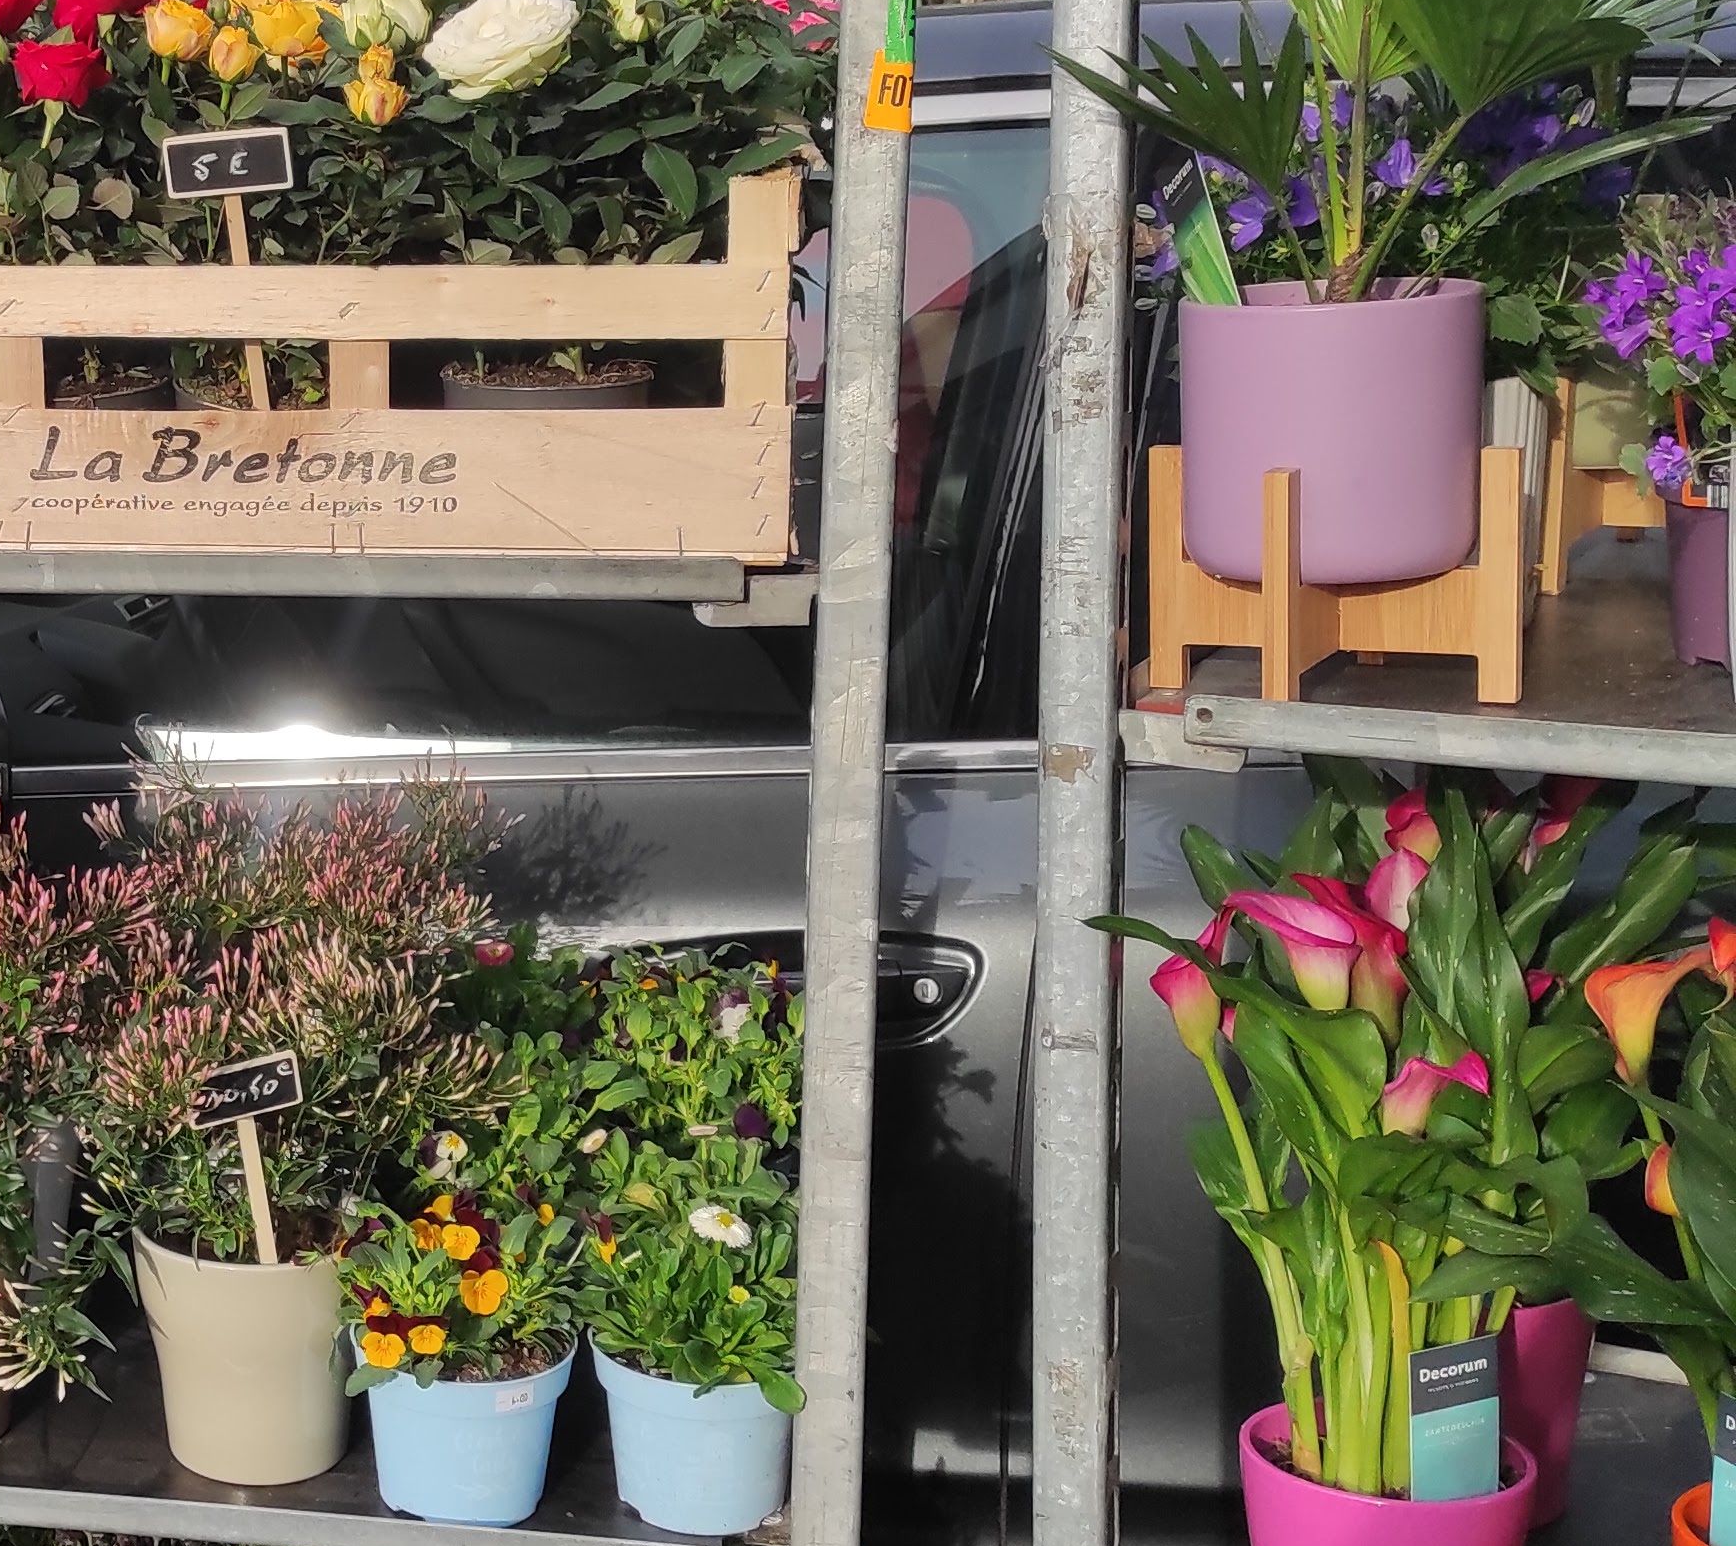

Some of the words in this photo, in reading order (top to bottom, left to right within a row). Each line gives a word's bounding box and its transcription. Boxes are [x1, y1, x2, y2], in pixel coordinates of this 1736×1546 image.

[1162, 158, 1194, 201] Decorum
[30, 425, 123, 483] La
[142, 426, 458, 485] Bretonne
[31, 493, 175, 514] coopérative
[183, 495, 291, 517] engagée
[300, 493, 383, 518] depuis
[393, 497, 459, 514] 1910
[1419, 1358, 1488, 1384] Decorum
